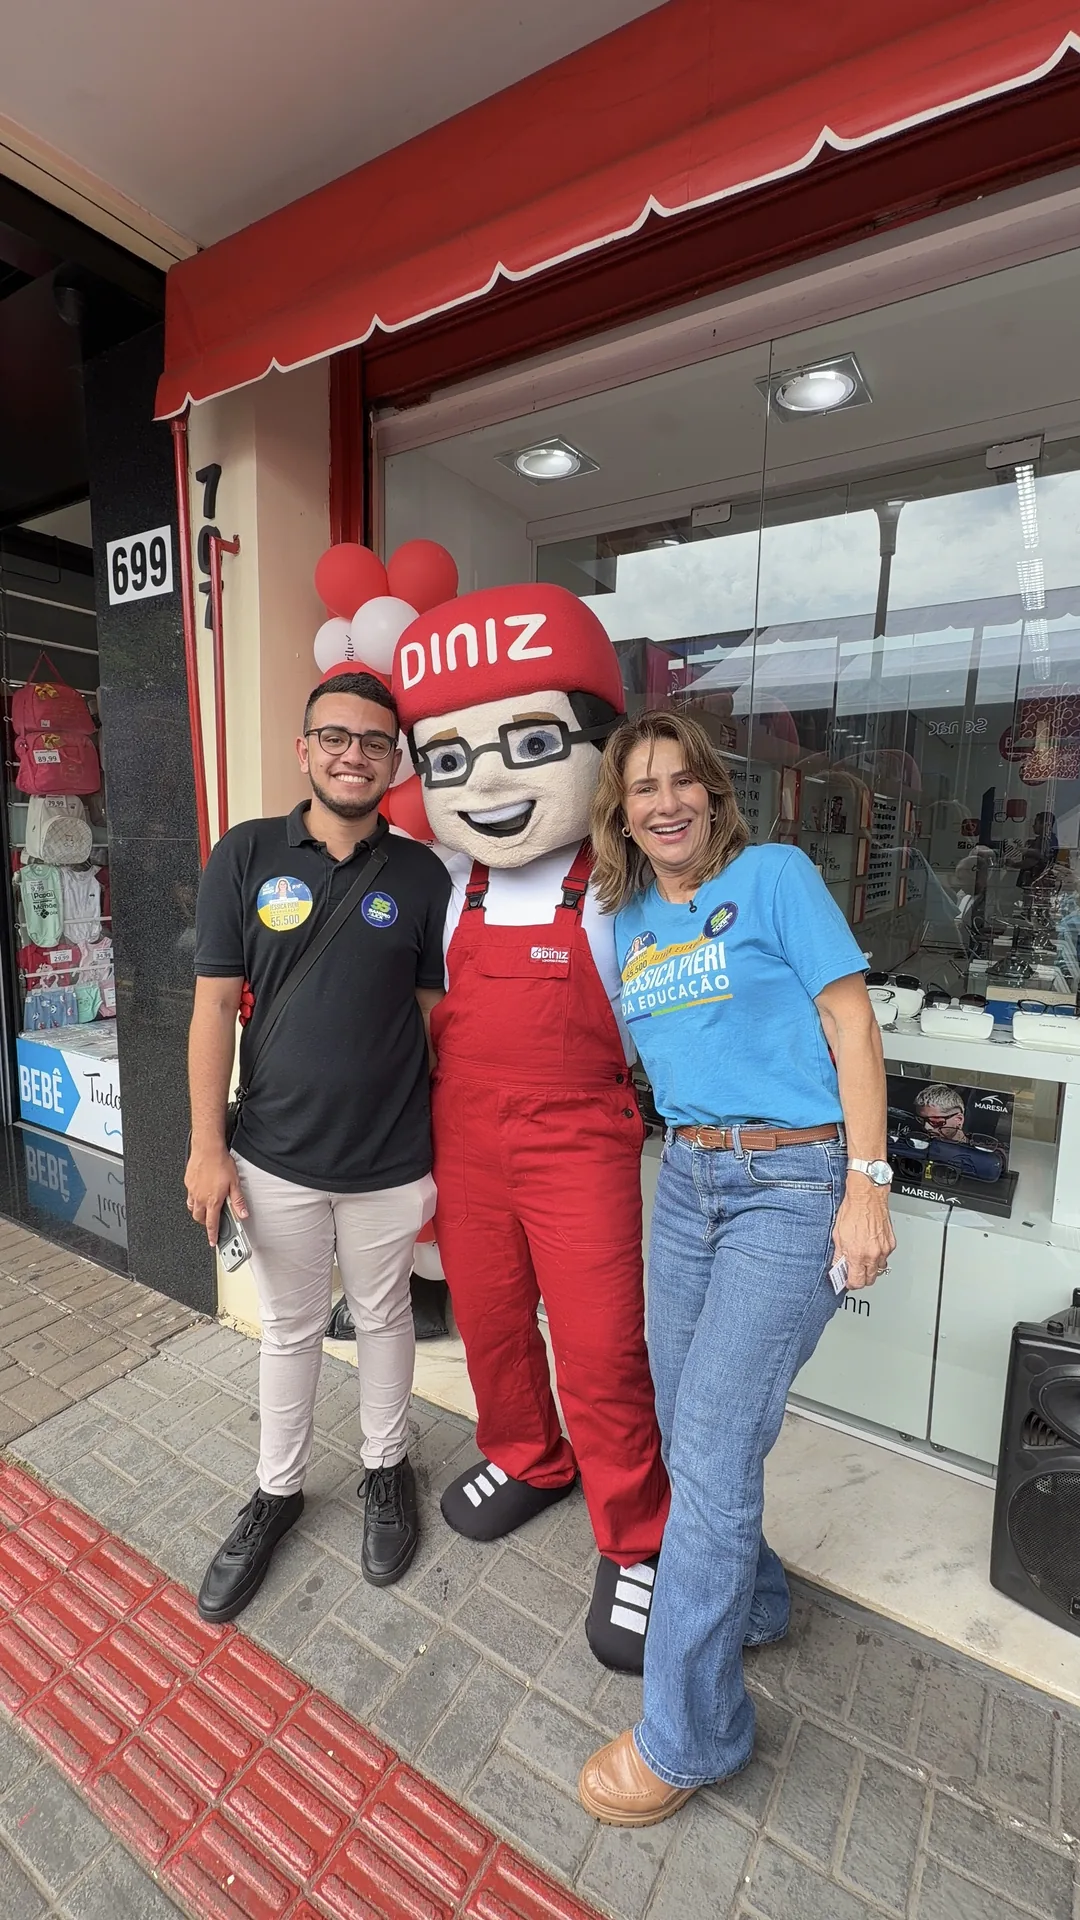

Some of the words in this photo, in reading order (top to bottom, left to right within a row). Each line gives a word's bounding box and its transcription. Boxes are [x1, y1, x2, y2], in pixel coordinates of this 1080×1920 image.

[112, 536, 167, 596] 699
[271, 914, 300, 927] 55.500
[677, 941, 727, 980] PIERI
[621, 1000, 635, 1017] DA
[639, 973, 730, 1011] EDUCAÇÃO
[19, 1064, 65, 1115] BEBÊ
[974, 1102, 1008, 1113] MARESIA
[901, 1185, 946, 1203] MARESIA
